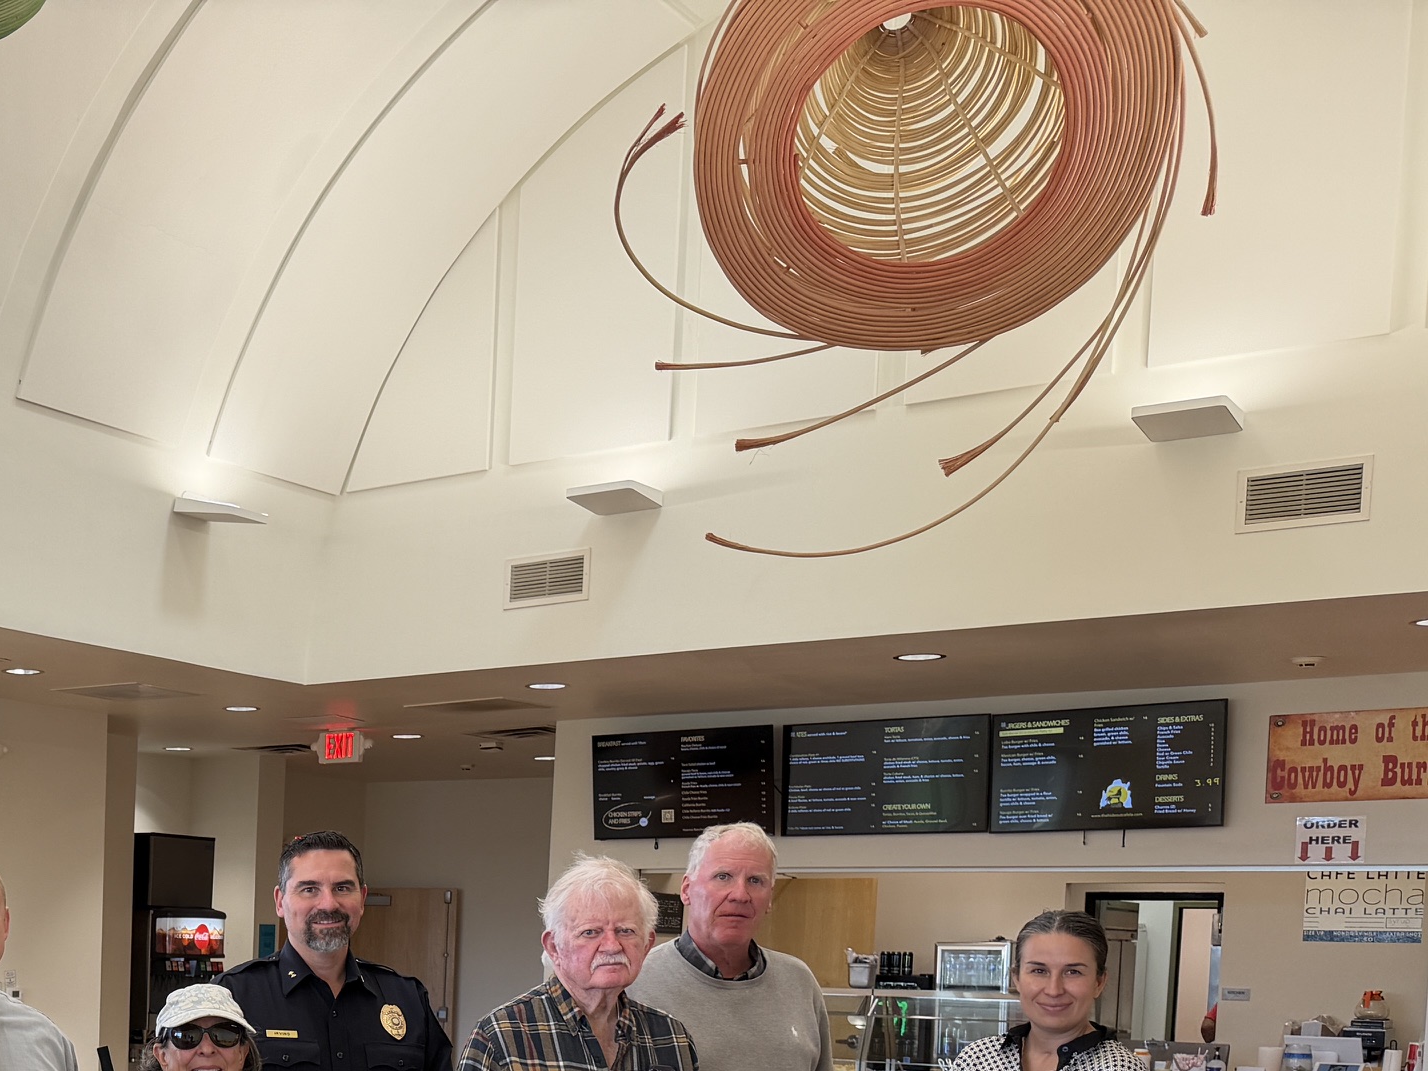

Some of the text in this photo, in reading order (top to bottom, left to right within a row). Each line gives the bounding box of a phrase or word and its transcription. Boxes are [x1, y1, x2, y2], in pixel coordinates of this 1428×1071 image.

[1032, 719, 1070, 728] SANDWICHES
[1157, 716, 1174, 724] SIDES
[1180, 714, 1203, 723] EXTRAS
[1300, 719, 1359, 747] Home
[1375, 714, 1396, 743] of
[326, 733, 354, 759] EXIT
[1155, 773, 1178, 781] DRINKS
[1194, 777, 1220, 787] 3.99
[1272, 757, 1364, 797] Cowboy
[1154, 795, 1184, 803] DESSERTS
[1303, 819, 1359, 829] ORDER
[1308, 835, 1352, 845] HERE
[1306, 883, 1424, 906] mocha
[1305, 907, 1424, 916] CHAI LATTE
